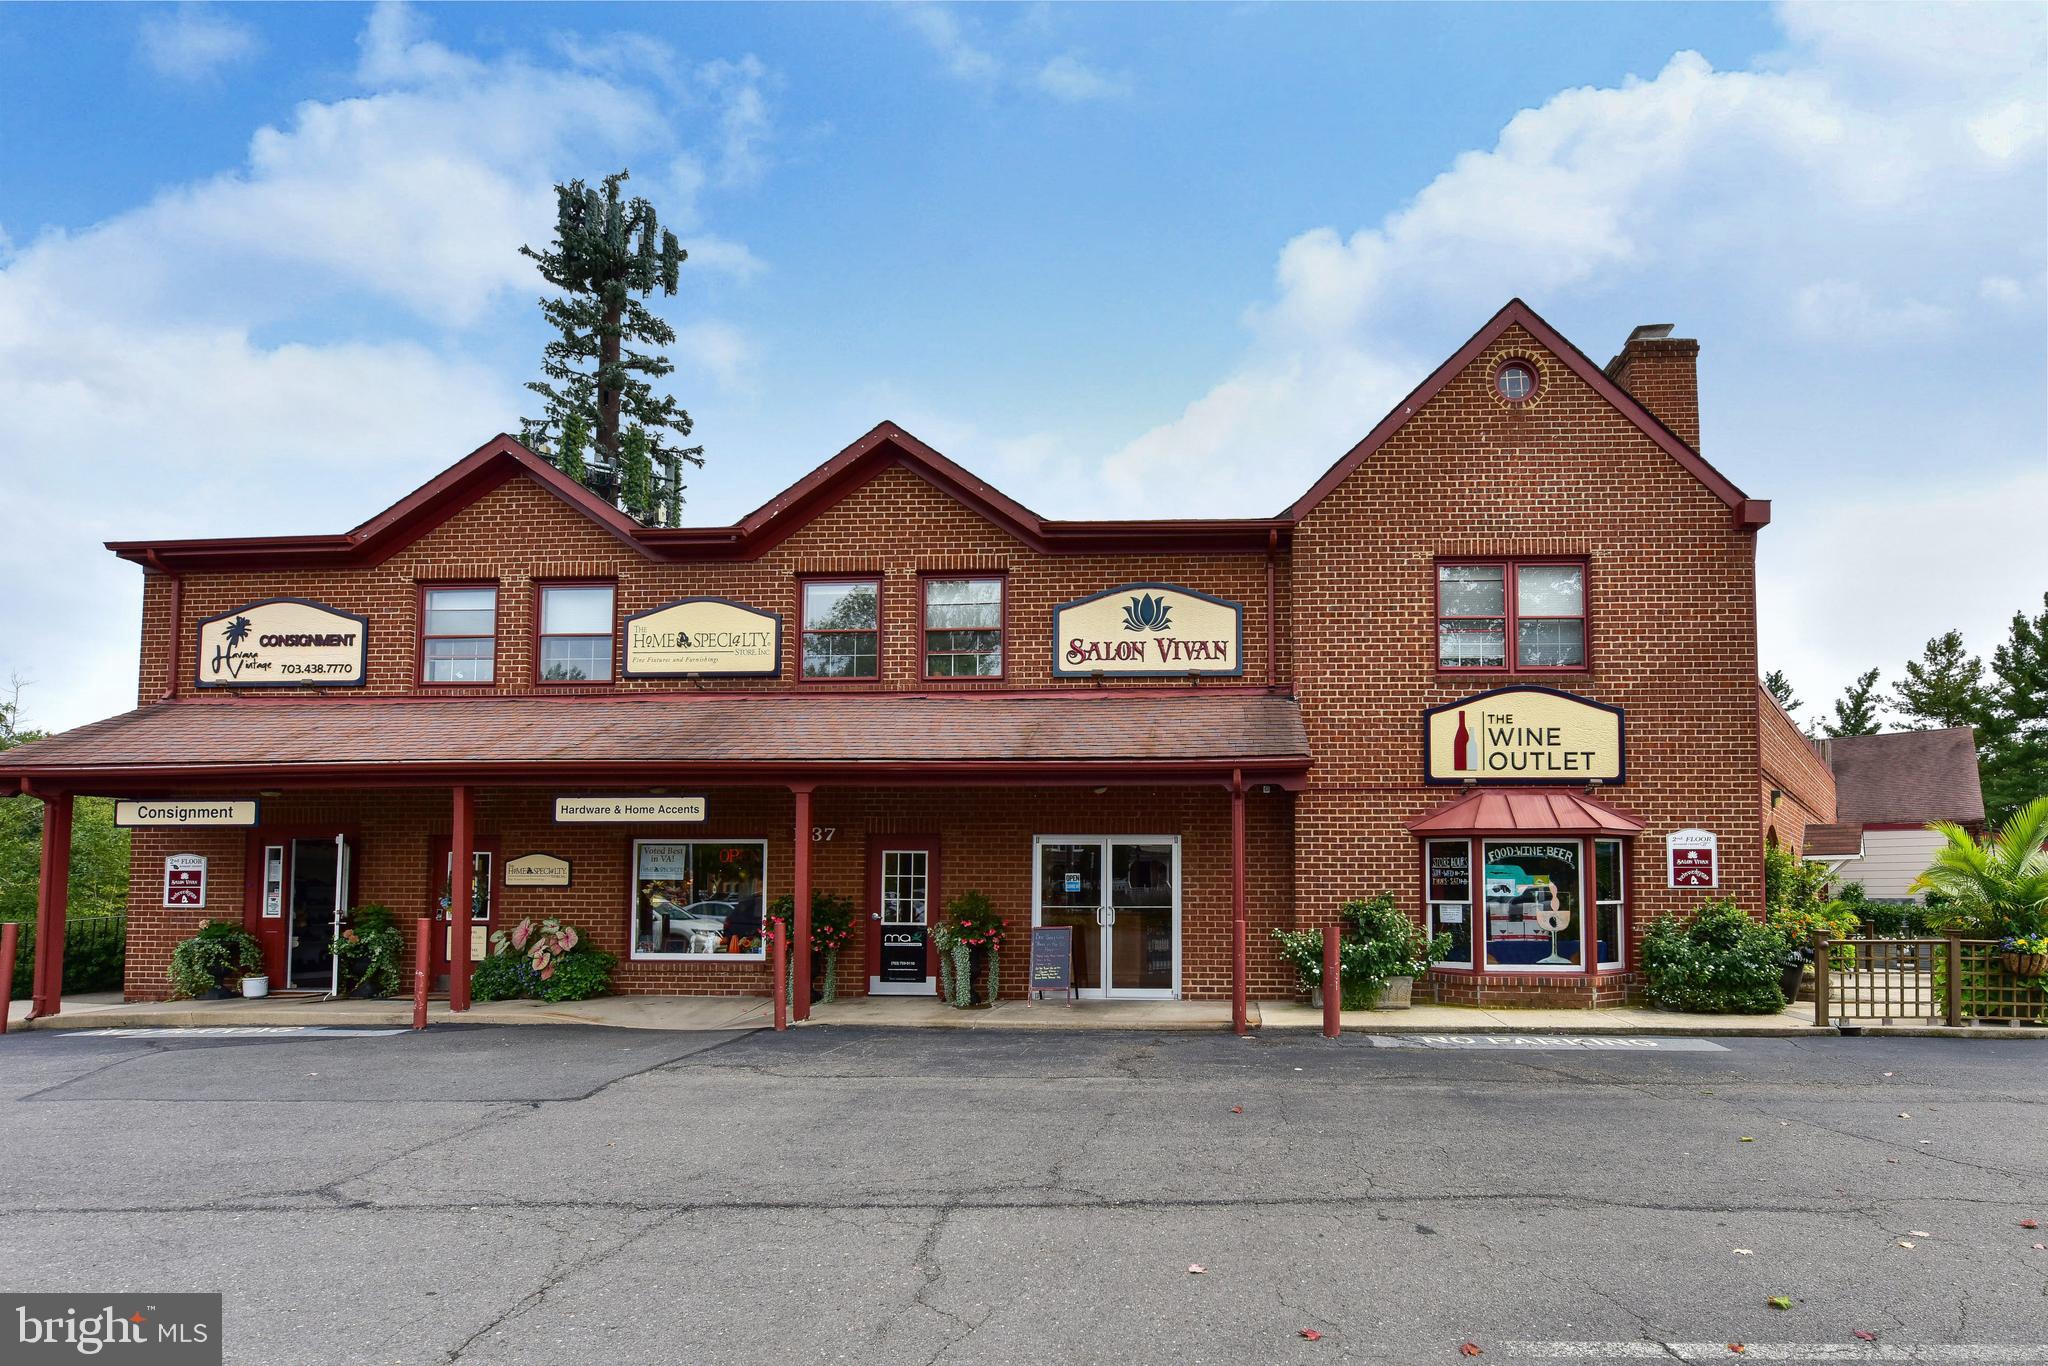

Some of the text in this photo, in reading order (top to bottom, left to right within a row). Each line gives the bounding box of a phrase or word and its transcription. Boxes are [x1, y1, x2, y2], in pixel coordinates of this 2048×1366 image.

[633, 625, 647, 633] THE
[259, 633, 356, 648] CONSIGNMENT
[1066, 637, 1229, 665] SALON VIVAN
[212, 644, 259, 674] Havana
[227, 658, 272, 679] Vintage
[280, 664, 352, 675] 703.438.7770
[1487, 714, 1513, 724] THE
[1488, 727, 1561, 746] WINE
[1489, 751, 1596, 770] OUTLET
[138, 806, 233, 821] Consignment
[561, 804, 700, 814] Hardware & Home Accents
[644, 847, 683, 855] Voted Best
[1420, 1035, 1658, 1047] NO PARKING
